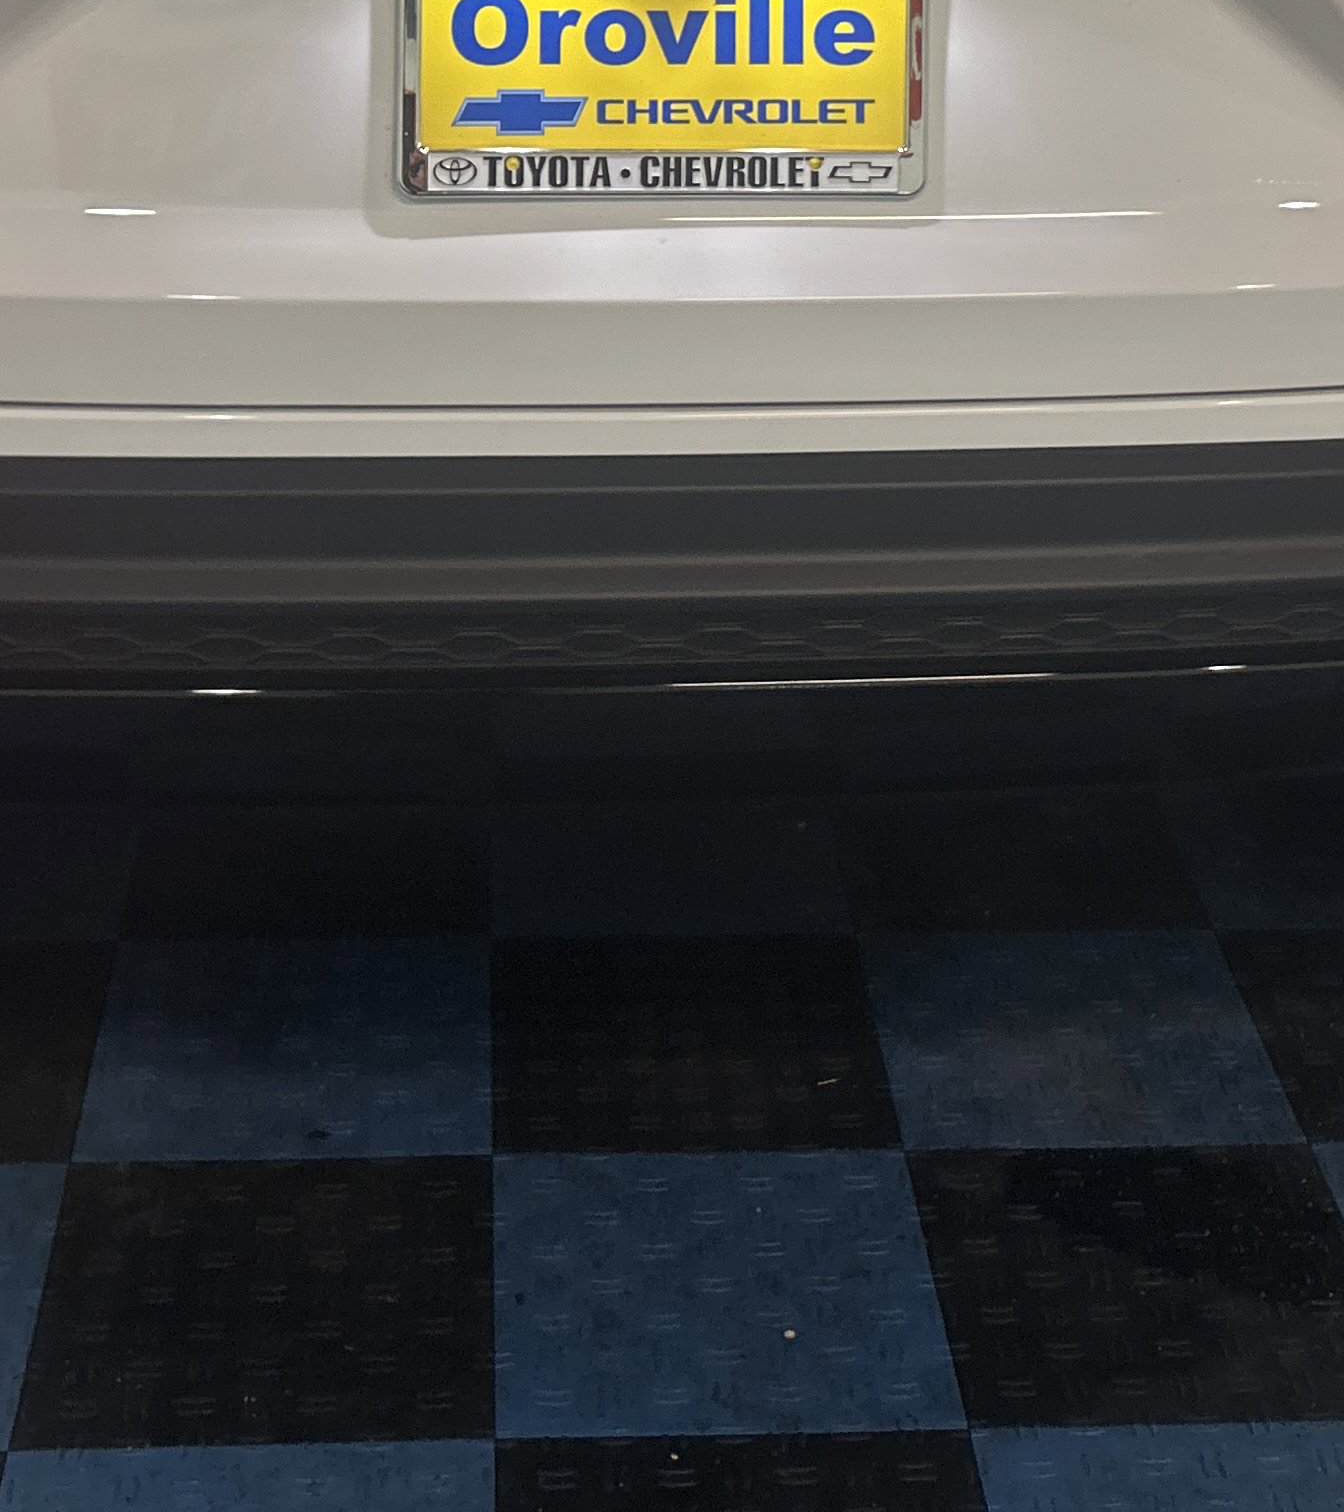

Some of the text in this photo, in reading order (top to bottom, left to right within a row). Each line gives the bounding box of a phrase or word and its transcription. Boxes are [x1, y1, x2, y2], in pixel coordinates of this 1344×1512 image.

[596, 98, 876, 125] CHEVROLET
[483, 155, 825, 190] TOYOTA CHEVROLET
